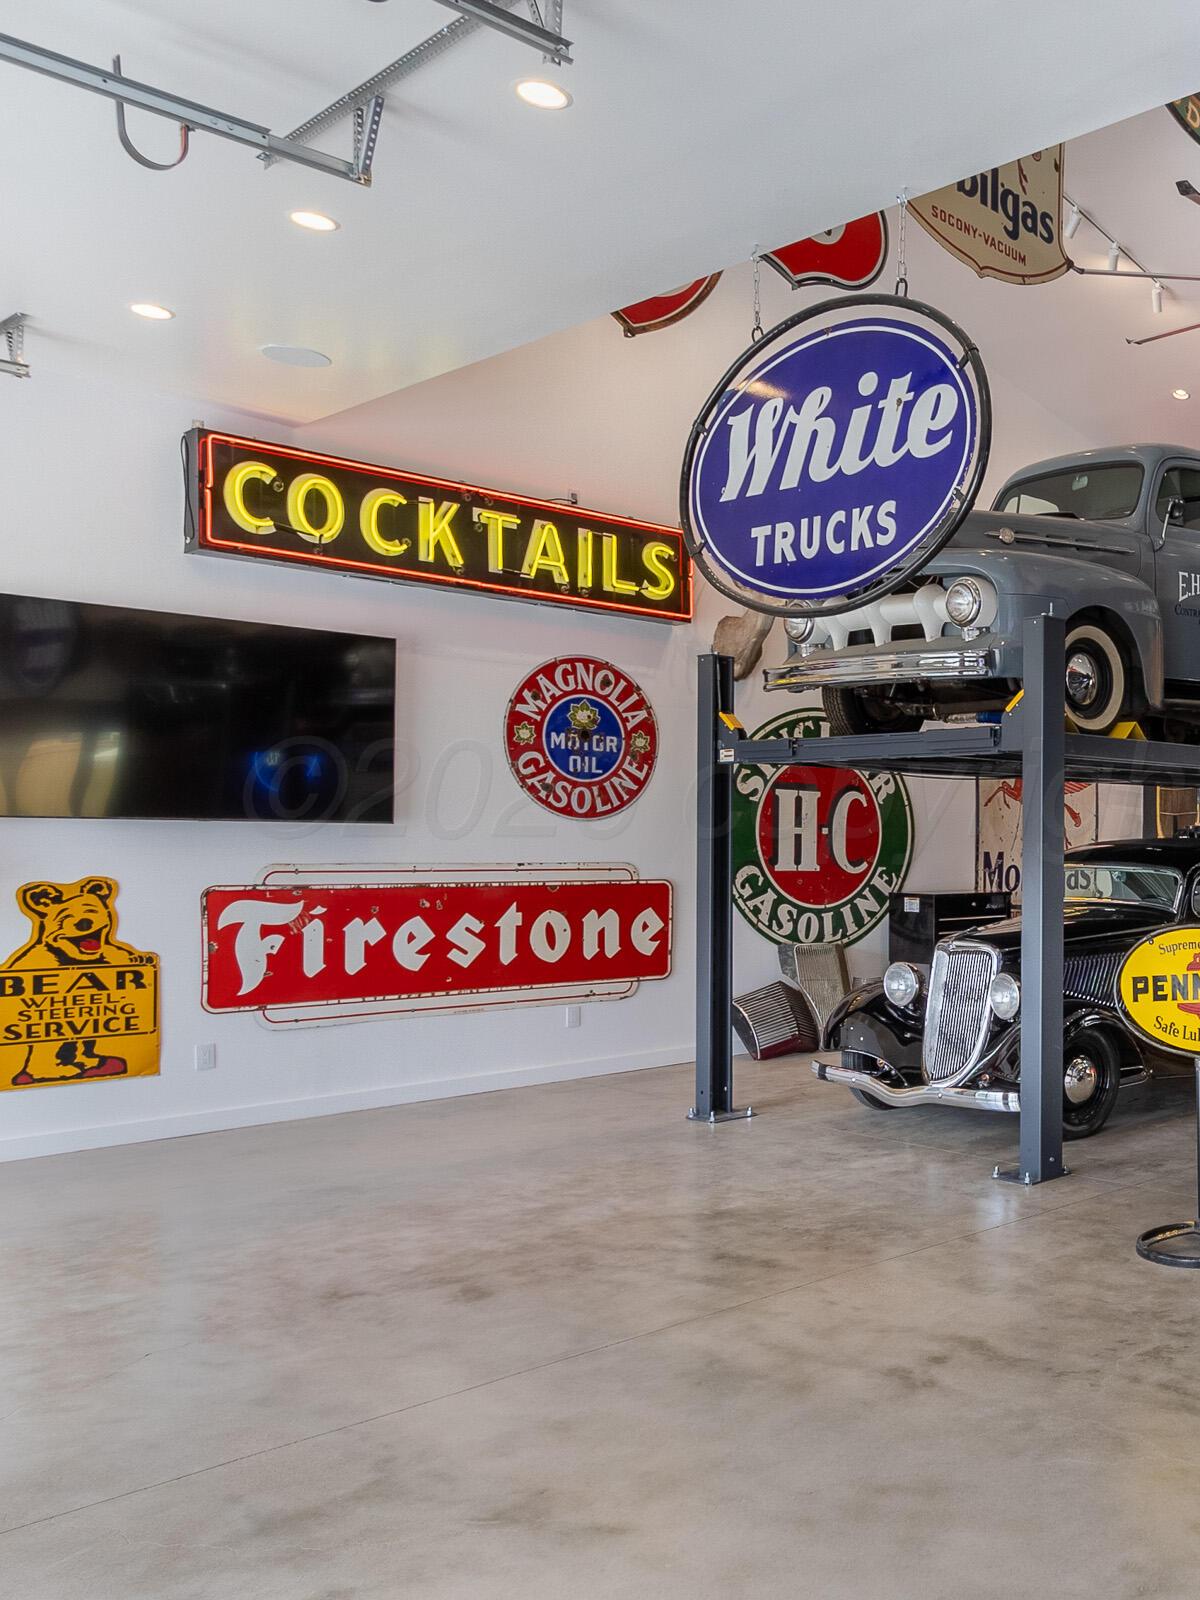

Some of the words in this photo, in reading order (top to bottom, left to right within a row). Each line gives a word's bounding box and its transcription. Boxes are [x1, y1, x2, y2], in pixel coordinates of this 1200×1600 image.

[931, 204, 1027, 266] SOCONY-VACUUM
[956, 167, 1054, 245] bilgas
[718, 370, 960, 503] White
[223, 460, 675, 601] COCKTAILS
[749, 499, 898, 567] TRUCKS
[515, 662, 649, 731] MAGNOLIA
[517, 751, 649, 814] GASOLINE
[568, 755, 603, 774] OIL
[734, 864, 897, 944] GASOLINE
[217, 899, 665, 996] Firestone
[0, 969, 147, 998] BEAR
[17, 1002, 136, 1022] STEERING
[3, 1015, 141, 1041] SERVICE
[1153, 1015, 1180, 1037] Safe
